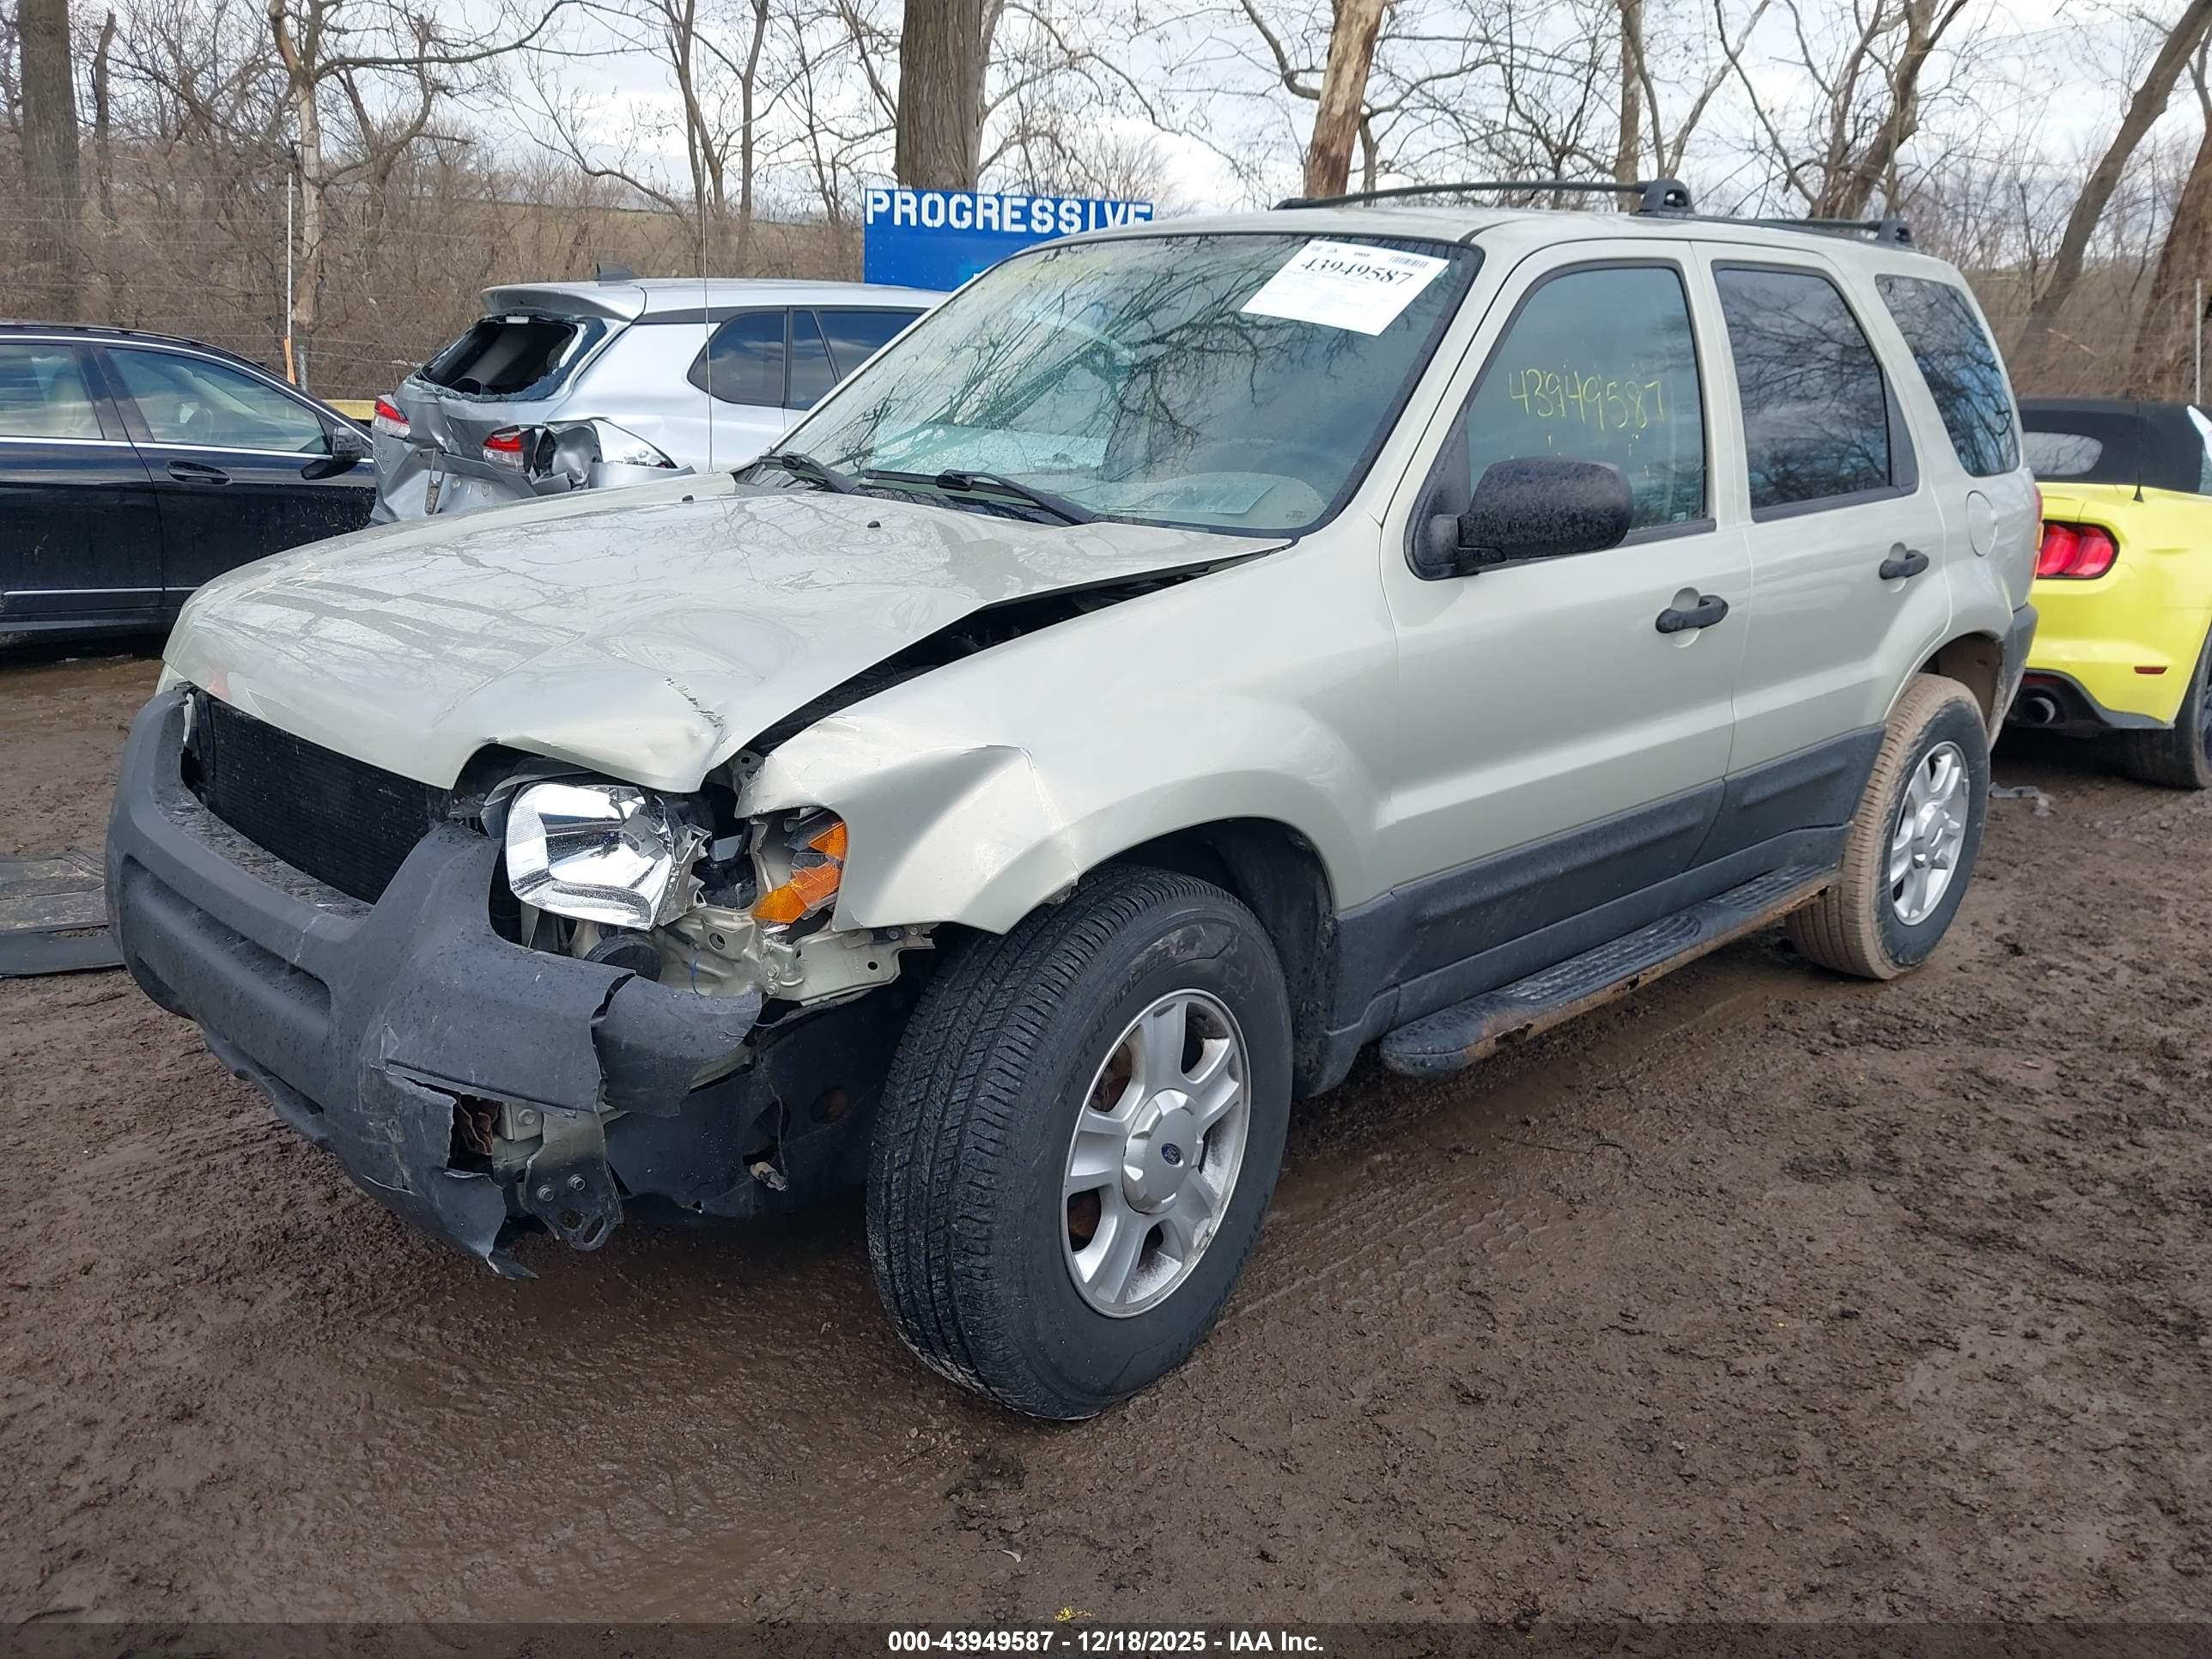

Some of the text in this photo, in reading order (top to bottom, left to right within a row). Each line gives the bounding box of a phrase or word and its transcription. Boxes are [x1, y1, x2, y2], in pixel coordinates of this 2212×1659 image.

[866, 190, 1152, 234] PROGRESSIVE
[1300, 258, 1415, 286] 43949587
[1508, 368, 1665, 431] 43949587
